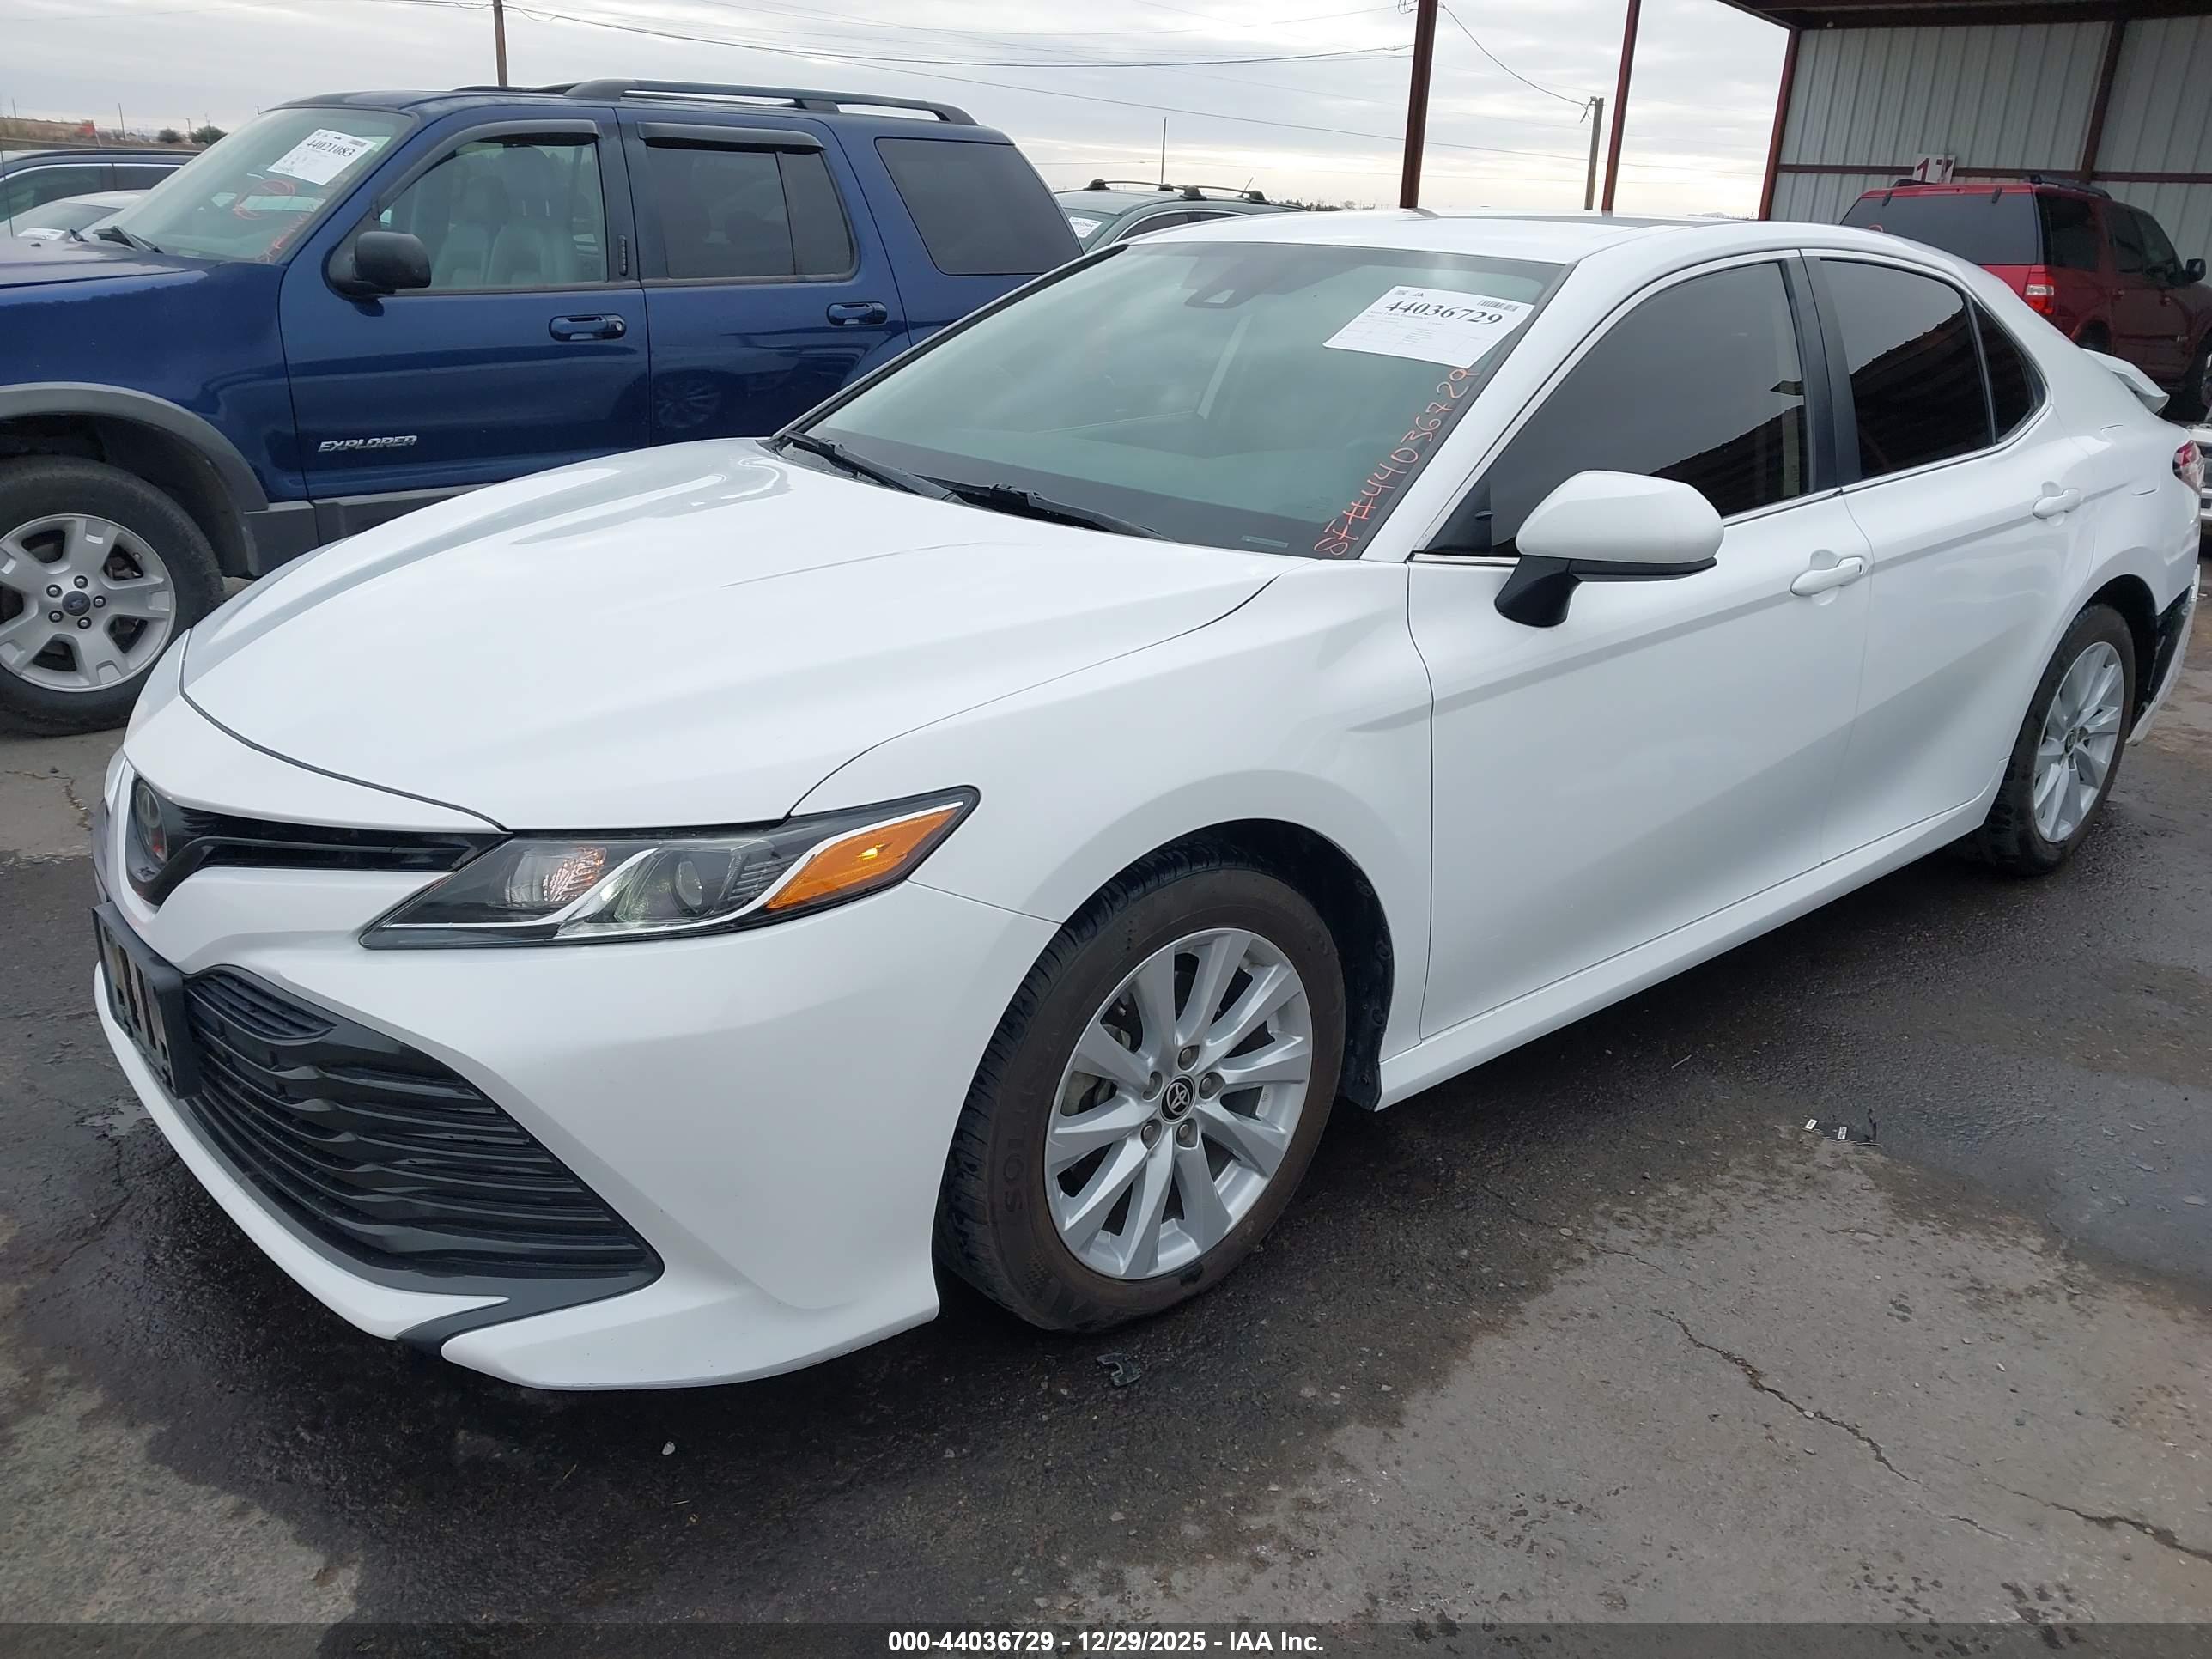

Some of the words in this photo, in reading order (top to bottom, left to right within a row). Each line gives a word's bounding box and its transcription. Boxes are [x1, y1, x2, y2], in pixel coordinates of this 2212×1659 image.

[307, 139, 356, 157] 44021083
[1385, 301, 1503, 325] 44036729
[318, 435, 417, 452] EXPLORER
